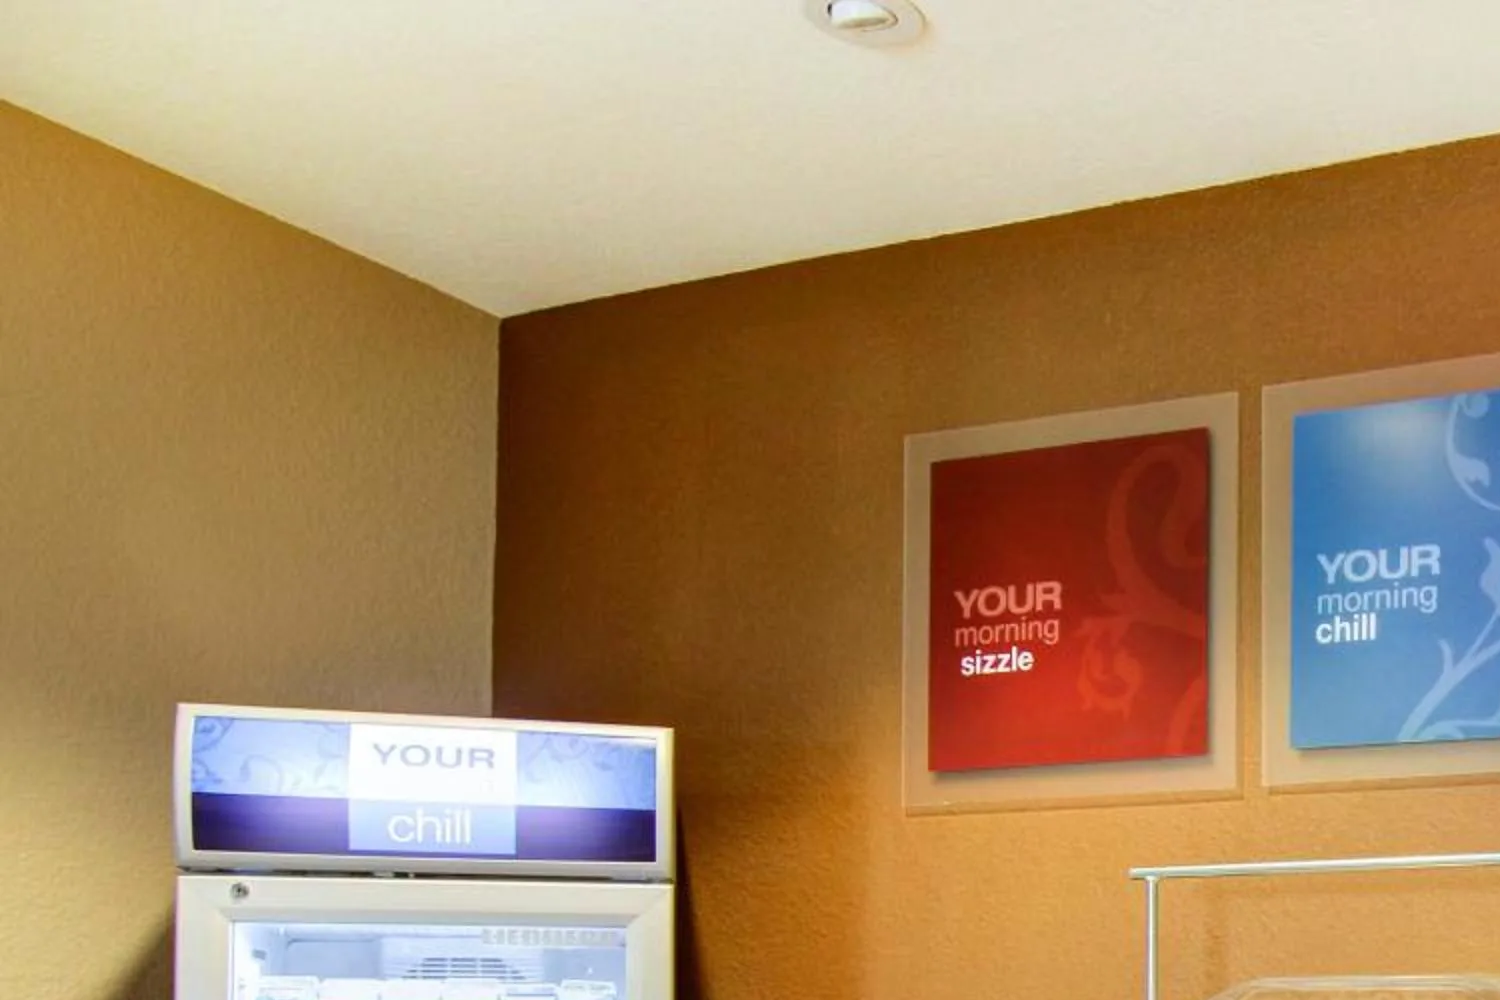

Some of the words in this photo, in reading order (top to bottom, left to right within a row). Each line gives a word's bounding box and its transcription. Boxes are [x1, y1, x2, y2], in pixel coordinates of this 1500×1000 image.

[1316, 543, 1441, 584] YOUR
[953, 581, 1062, 619] YOUR
[1316, 581, 1438, 614] morning
[954, 616, 1060, 648] morning
[1315, 612, 1377, 644] chill
[960, 646, 1035, 676] sizzle
[373, 743, 495, 768] YOUR
[387, 807, 471, 844] chill
